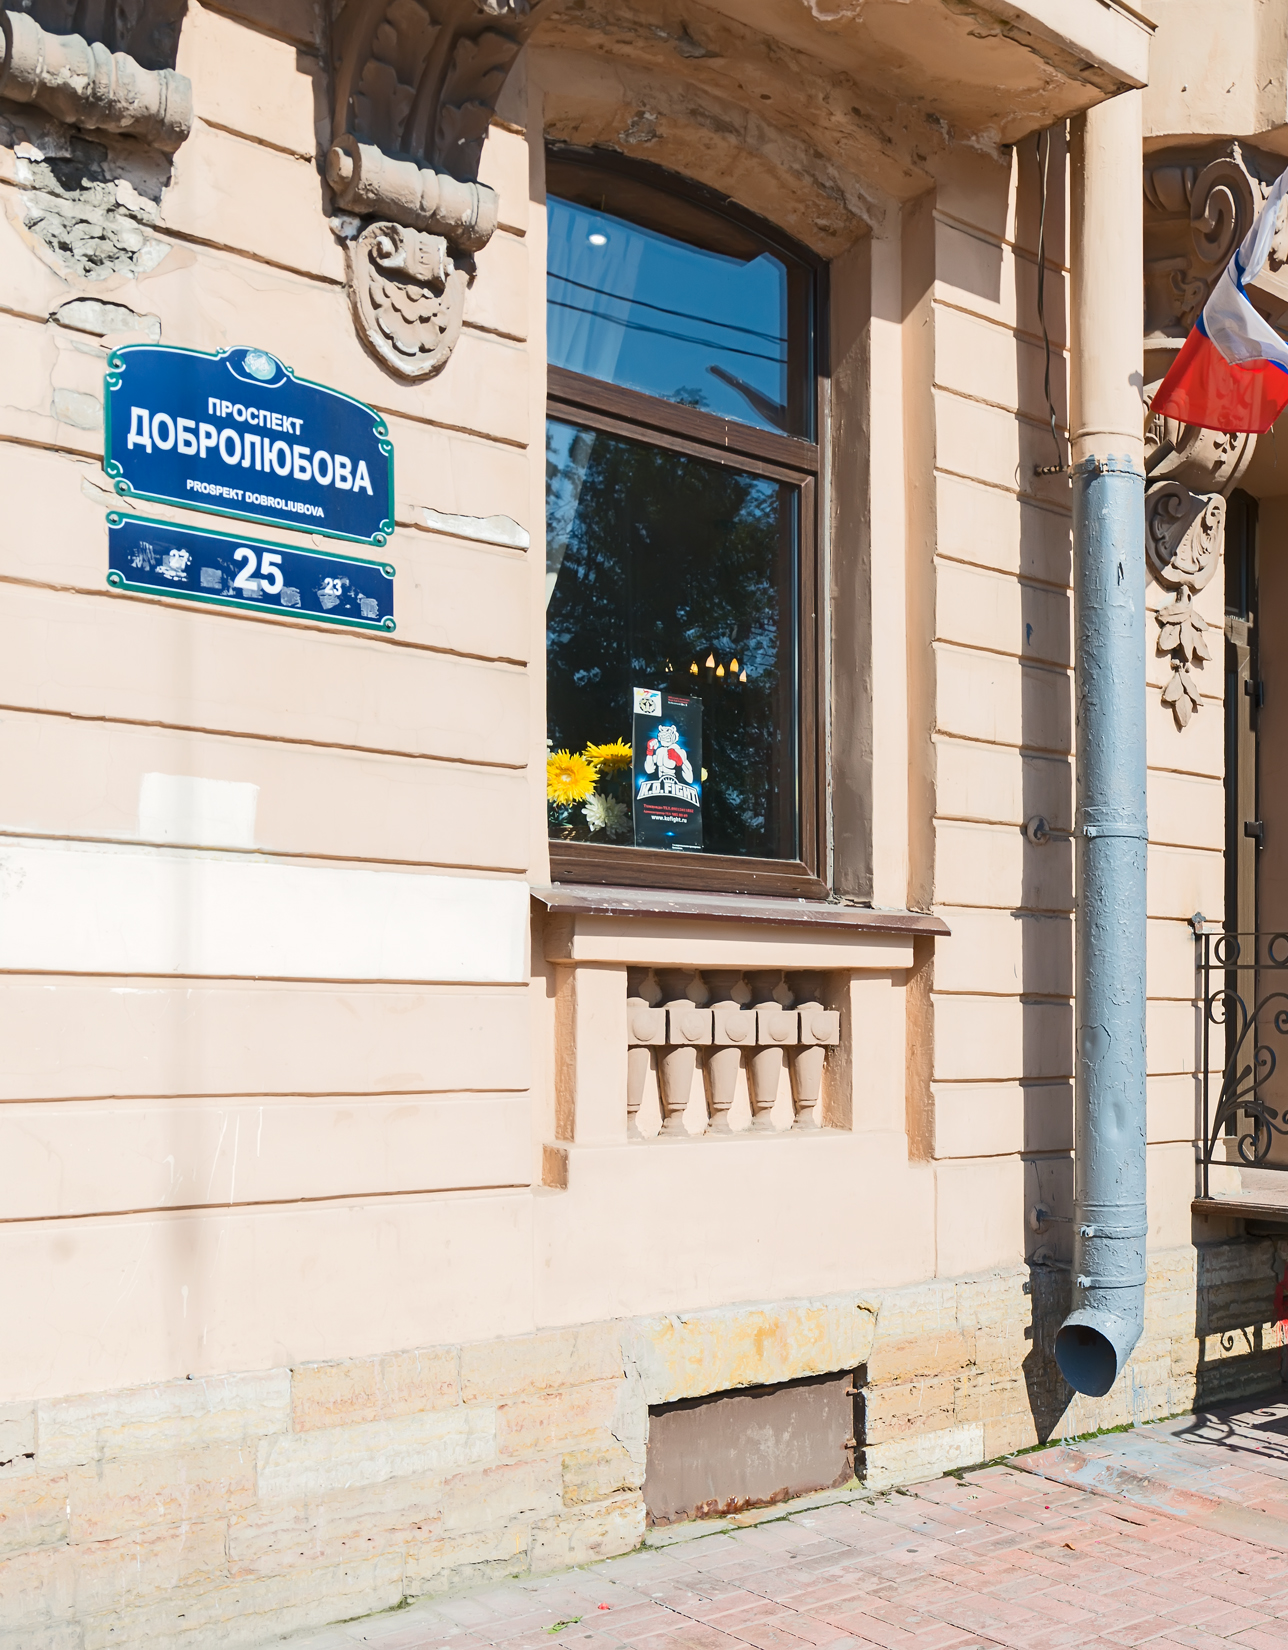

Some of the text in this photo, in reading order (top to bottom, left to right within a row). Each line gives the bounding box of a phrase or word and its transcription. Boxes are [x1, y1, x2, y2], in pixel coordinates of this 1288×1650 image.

[208, 397, 303, 435] ПРОСПЕКТ
[127, 406, 374, 496] ДОБРОЛЮБОВА
[186, 479, 324, 518] PROSPEKT DOBROLIUBOVA
[233, 546, 284, 595] 25
[323, 577, 343, 596] 23
[664, 781, 698, 805] FIGHT
